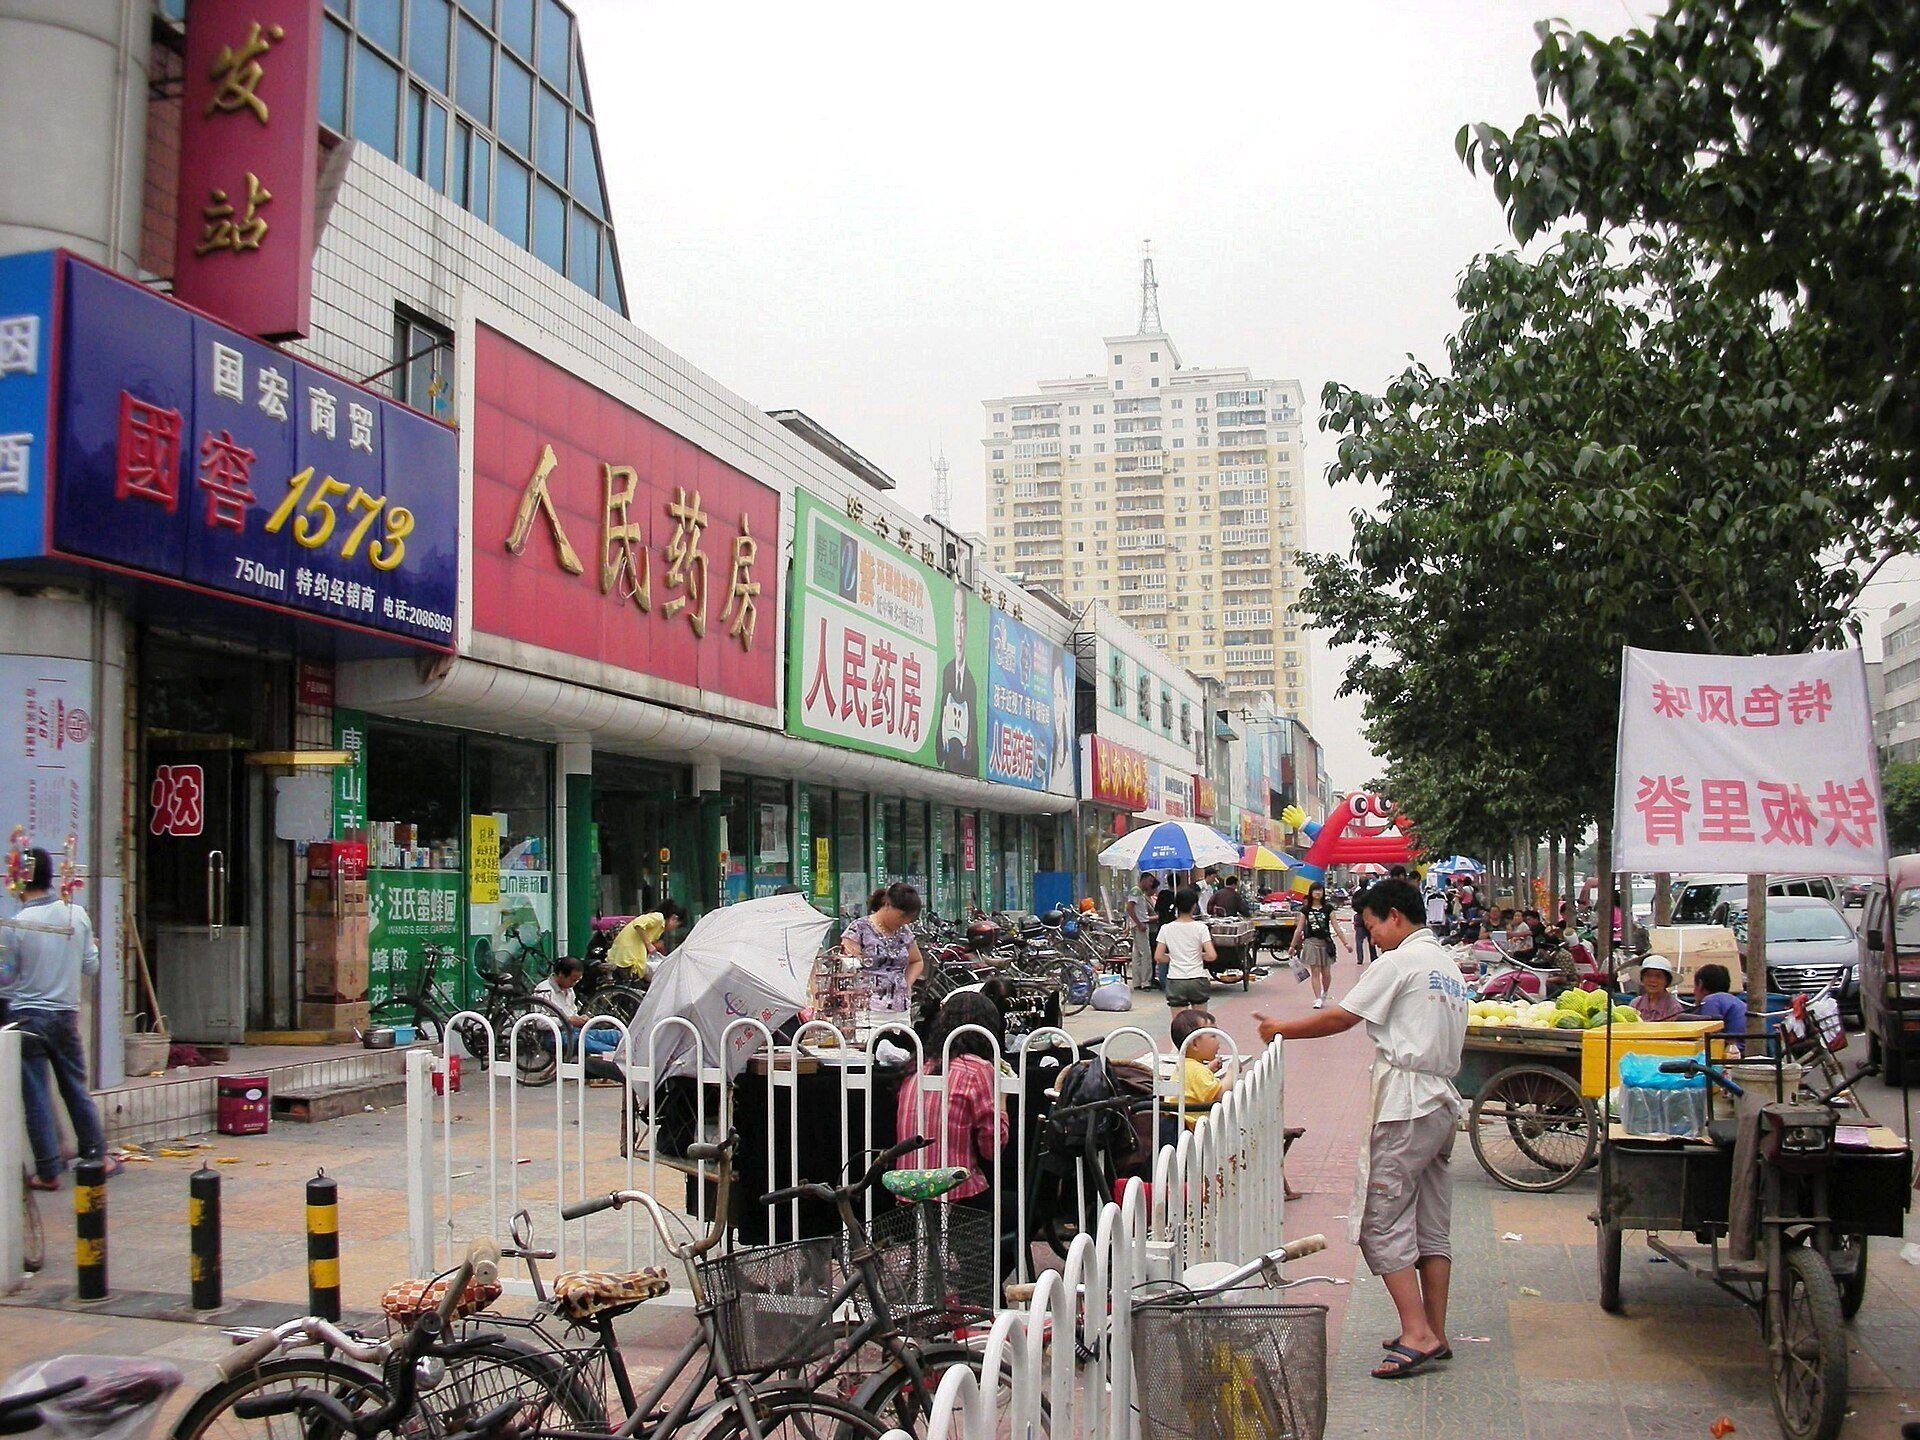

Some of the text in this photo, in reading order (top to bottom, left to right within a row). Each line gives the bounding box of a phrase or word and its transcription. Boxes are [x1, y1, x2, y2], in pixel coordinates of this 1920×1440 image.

[212, 341, 374, 455] 国宏商贸
[116, 389, 415, 571] 國窖 1573
[235, 556, 453, 634] 750ml 特约经销商 电话:2086869
[504, 443, 761, 652] 人民药房
[804, 616, 923, 745] 人民药房
[990, 720, 1034, 782] 人民药房
[388, 887, 457, 922] 汪氏蜜蜂园
[416, 925, 429, 935] BEE
